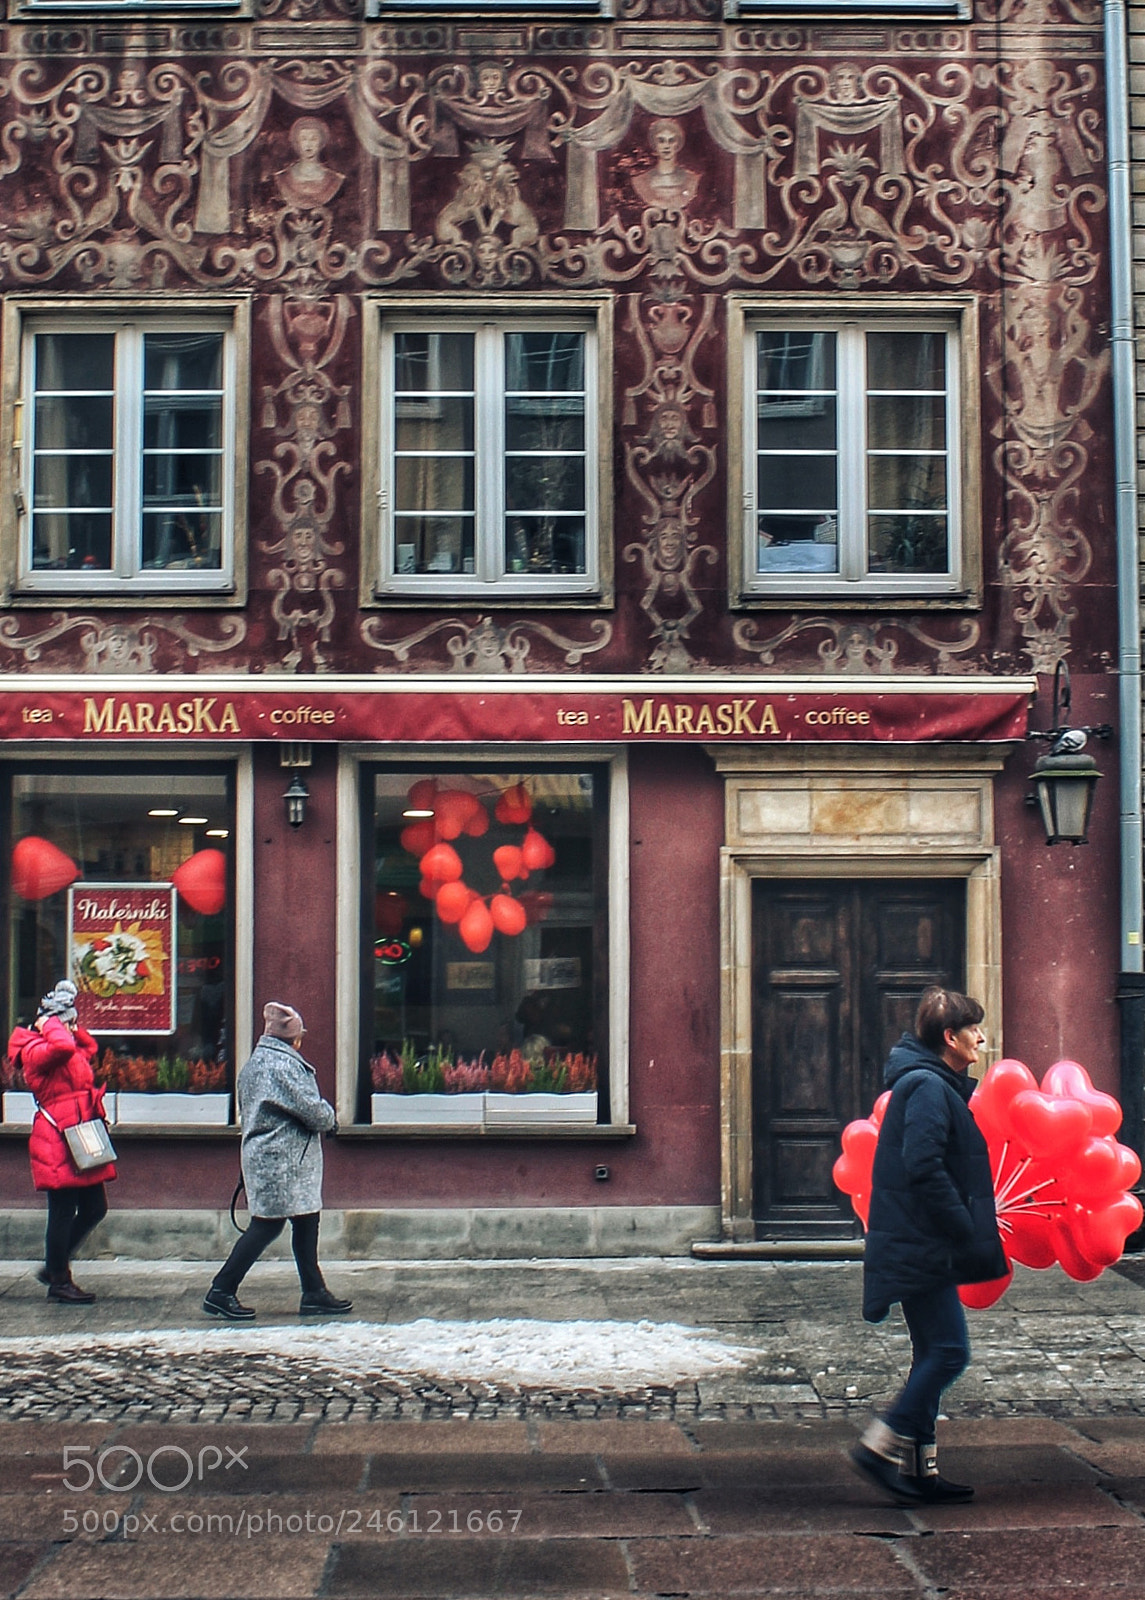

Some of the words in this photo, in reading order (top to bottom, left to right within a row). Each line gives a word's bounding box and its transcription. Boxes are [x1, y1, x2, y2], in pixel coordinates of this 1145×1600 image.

[22, 706, 53, 723] tea
[83, 698, 241, 734] MARASKA
[270, 706, 336, 724] coffee
[557, 708, 589, 725] tea
[622, 699, 781, 735] MARASKA
[805, 707, 870, 725] coffee
